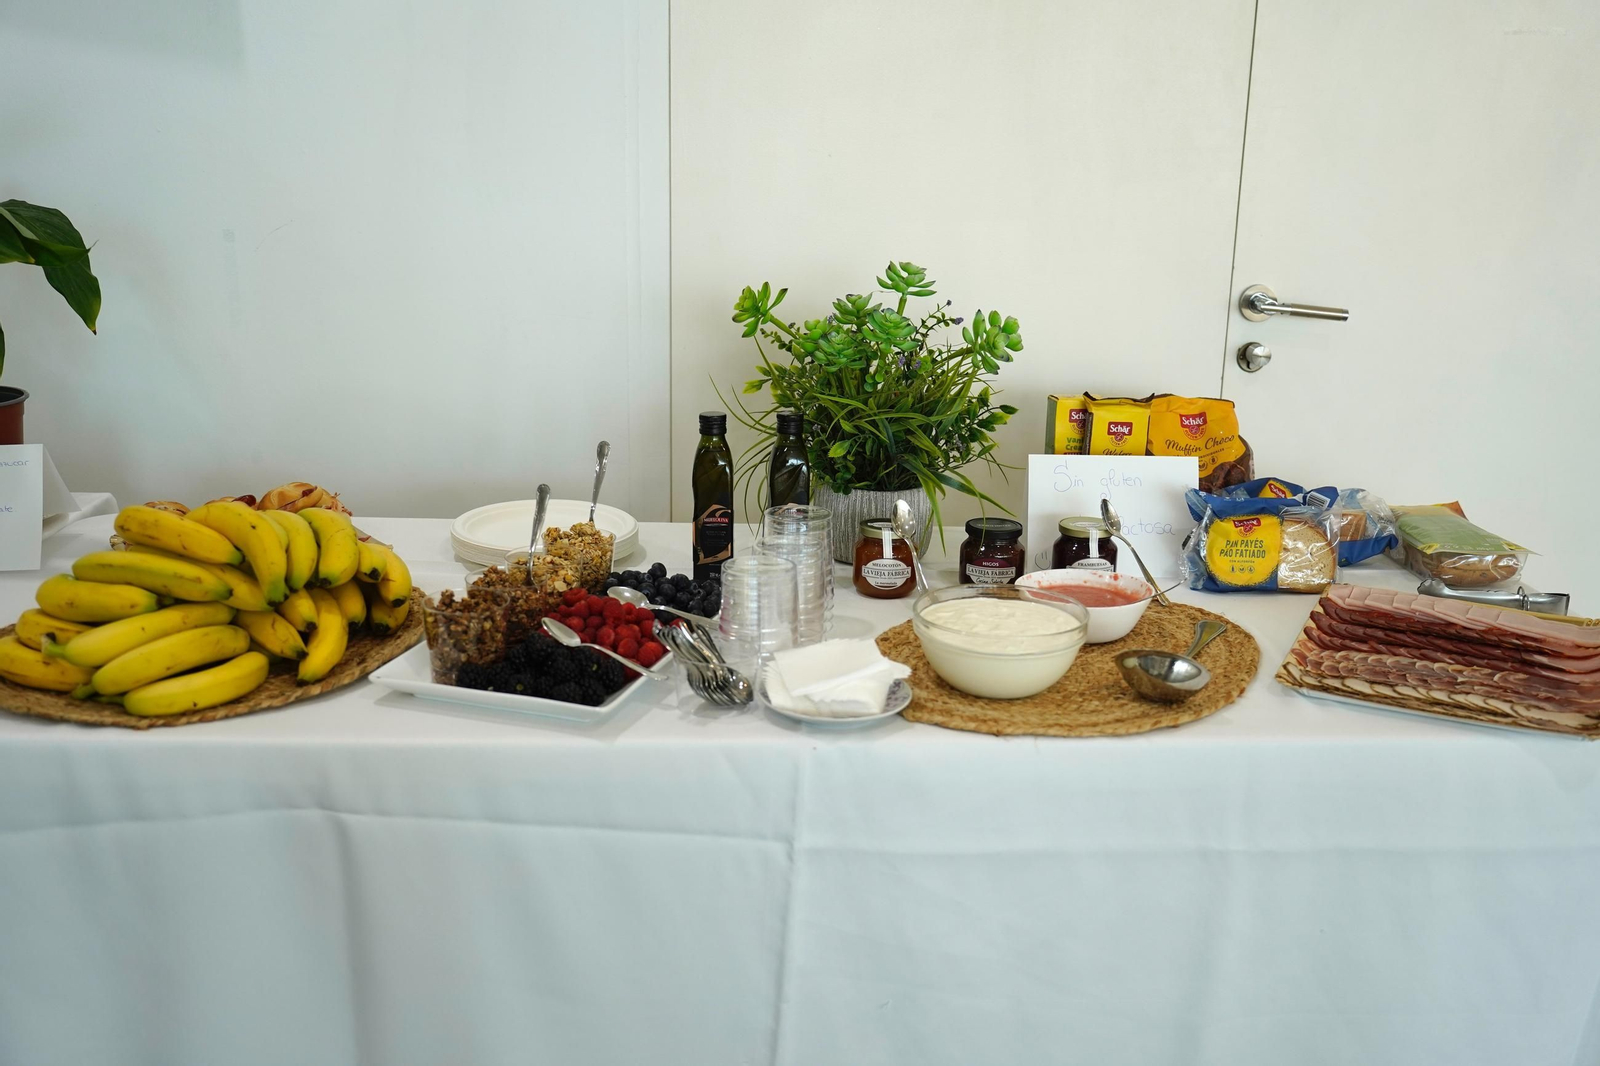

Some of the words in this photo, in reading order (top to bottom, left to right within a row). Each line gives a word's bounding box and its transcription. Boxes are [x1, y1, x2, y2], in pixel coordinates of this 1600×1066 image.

[1071, 411, 1087, 420] Sch
[1181, 416, 1205, 426] Schär
[1109, 424, 1131, 434] Schär
[1165, 439, 1203, 456] Muffin
[1204, 434, 1235, 450] Choco
[1054, 460, 1084, 492] Sin
[1100, 469, 1142, 499] gluten
[1225, 540, 1238, 549] PAN
[1240, 538, 1264, 549] PAYÉS
[1234, 549, 1266, 559] FATIADO
[870, 569, 886, 577] VIEJA
